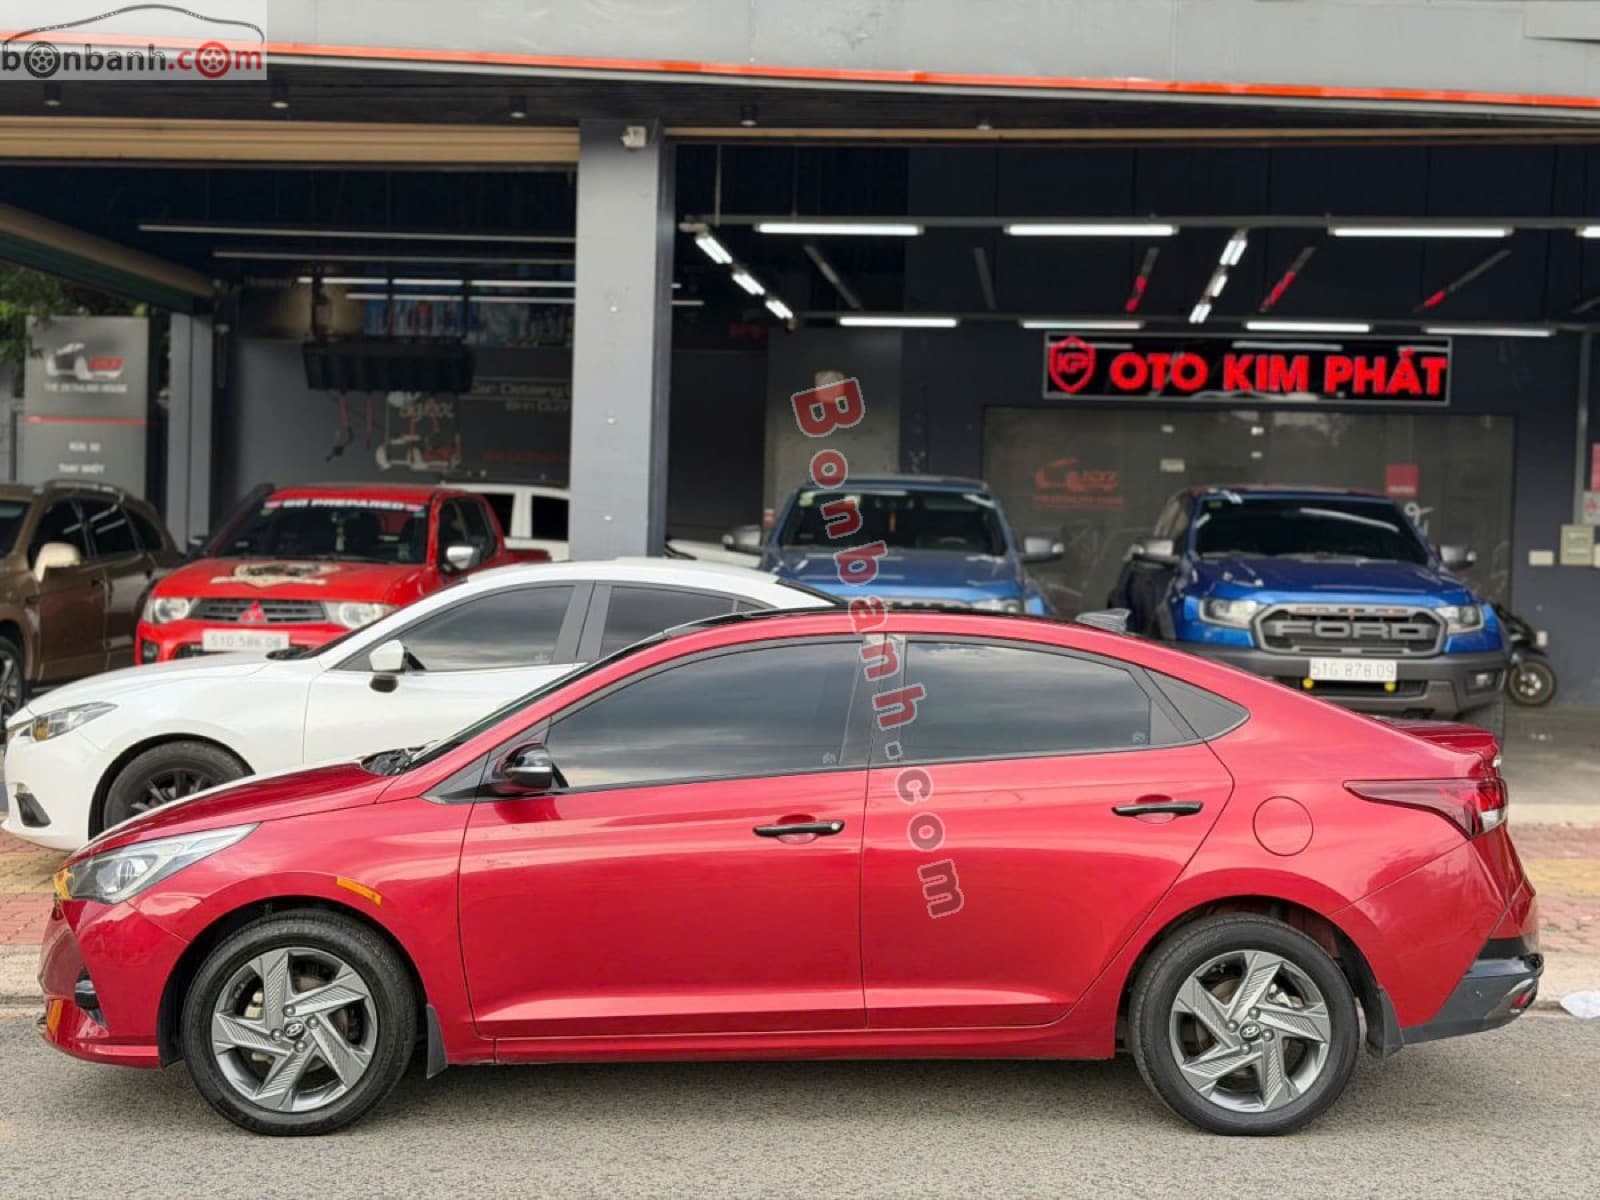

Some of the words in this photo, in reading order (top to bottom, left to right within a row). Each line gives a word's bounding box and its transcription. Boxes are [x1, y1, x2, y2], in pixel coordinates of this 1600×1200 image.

[1110, 352, 1209, 391] OTO
[1223, 354, 1309, 393] KIM
[1273, 620, 1429, 640] FORD
